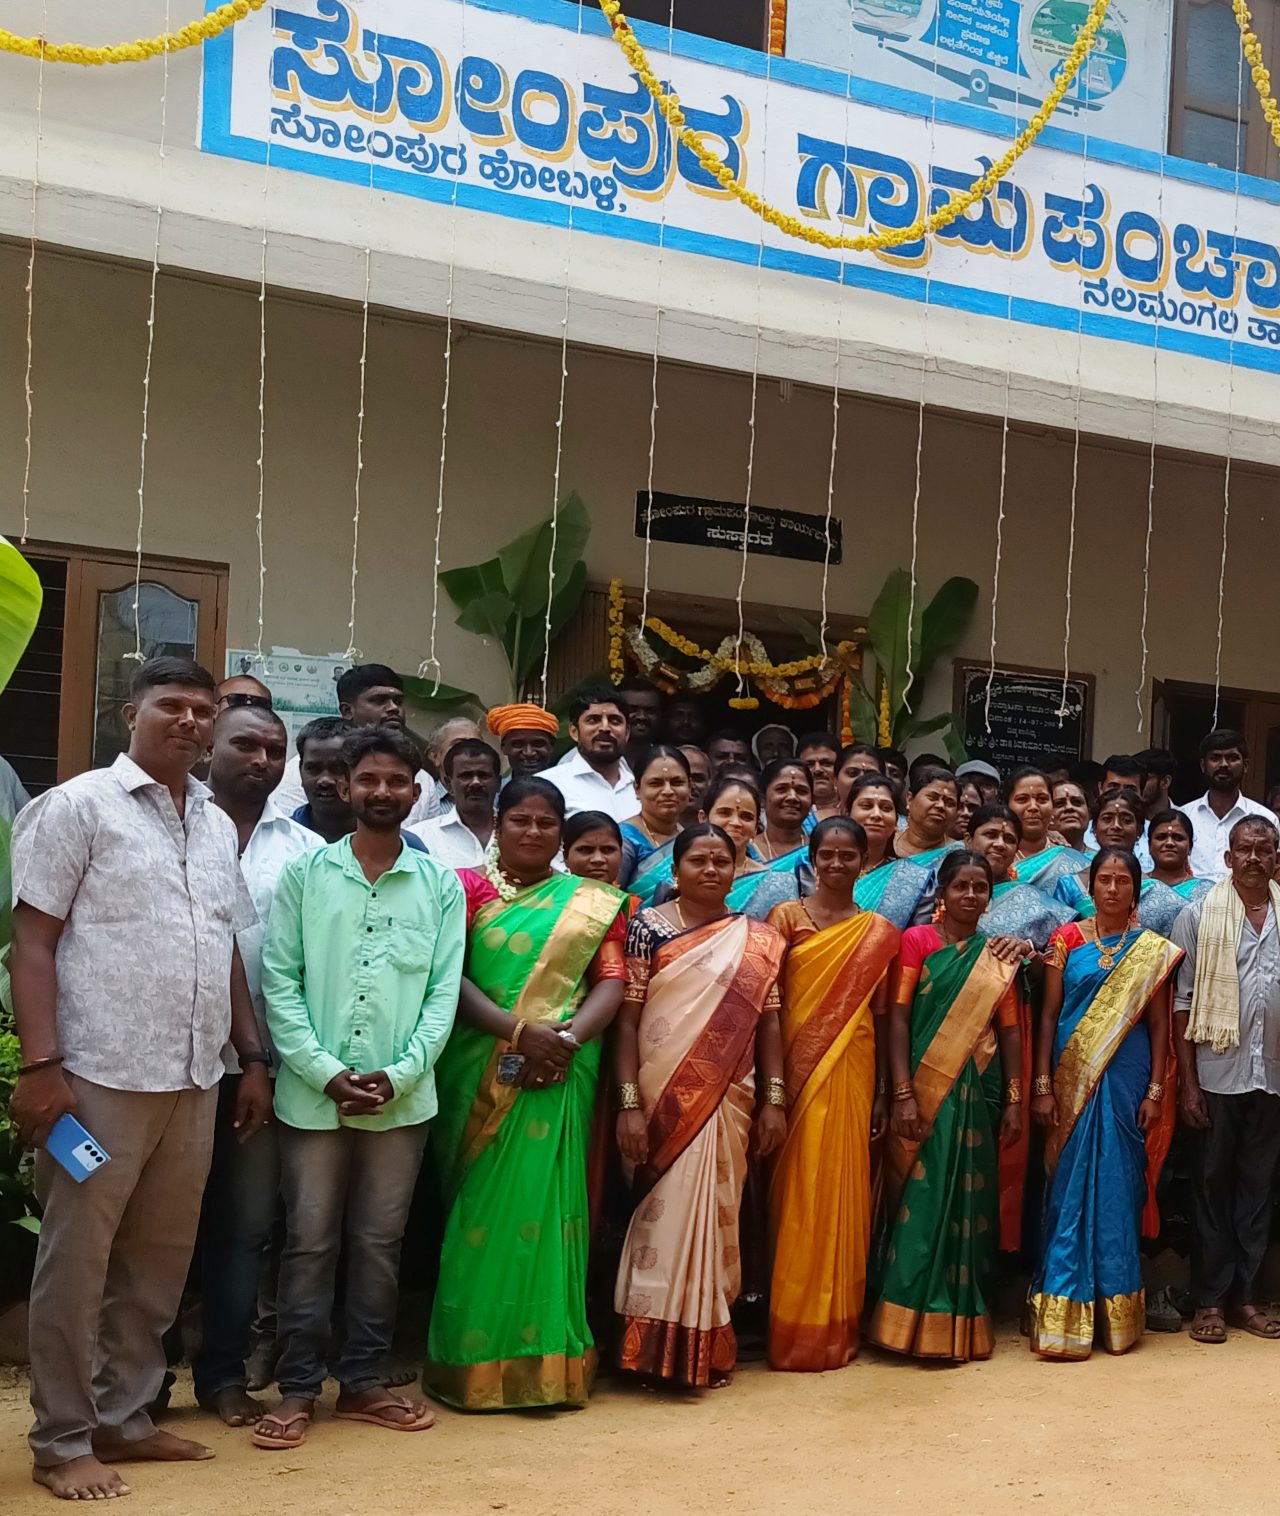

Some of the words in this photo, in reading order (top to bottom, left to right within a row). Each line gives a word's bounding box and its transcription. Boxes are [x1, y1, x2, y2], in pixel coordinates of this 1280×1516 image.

[271, 0, 748, 200] ಸೋಂಪುರ
[270, 103, 468, 176] ಸೋಂಪುರ
[1083, 278, 1238, 334] ನೆಲಮಂಗಲ
